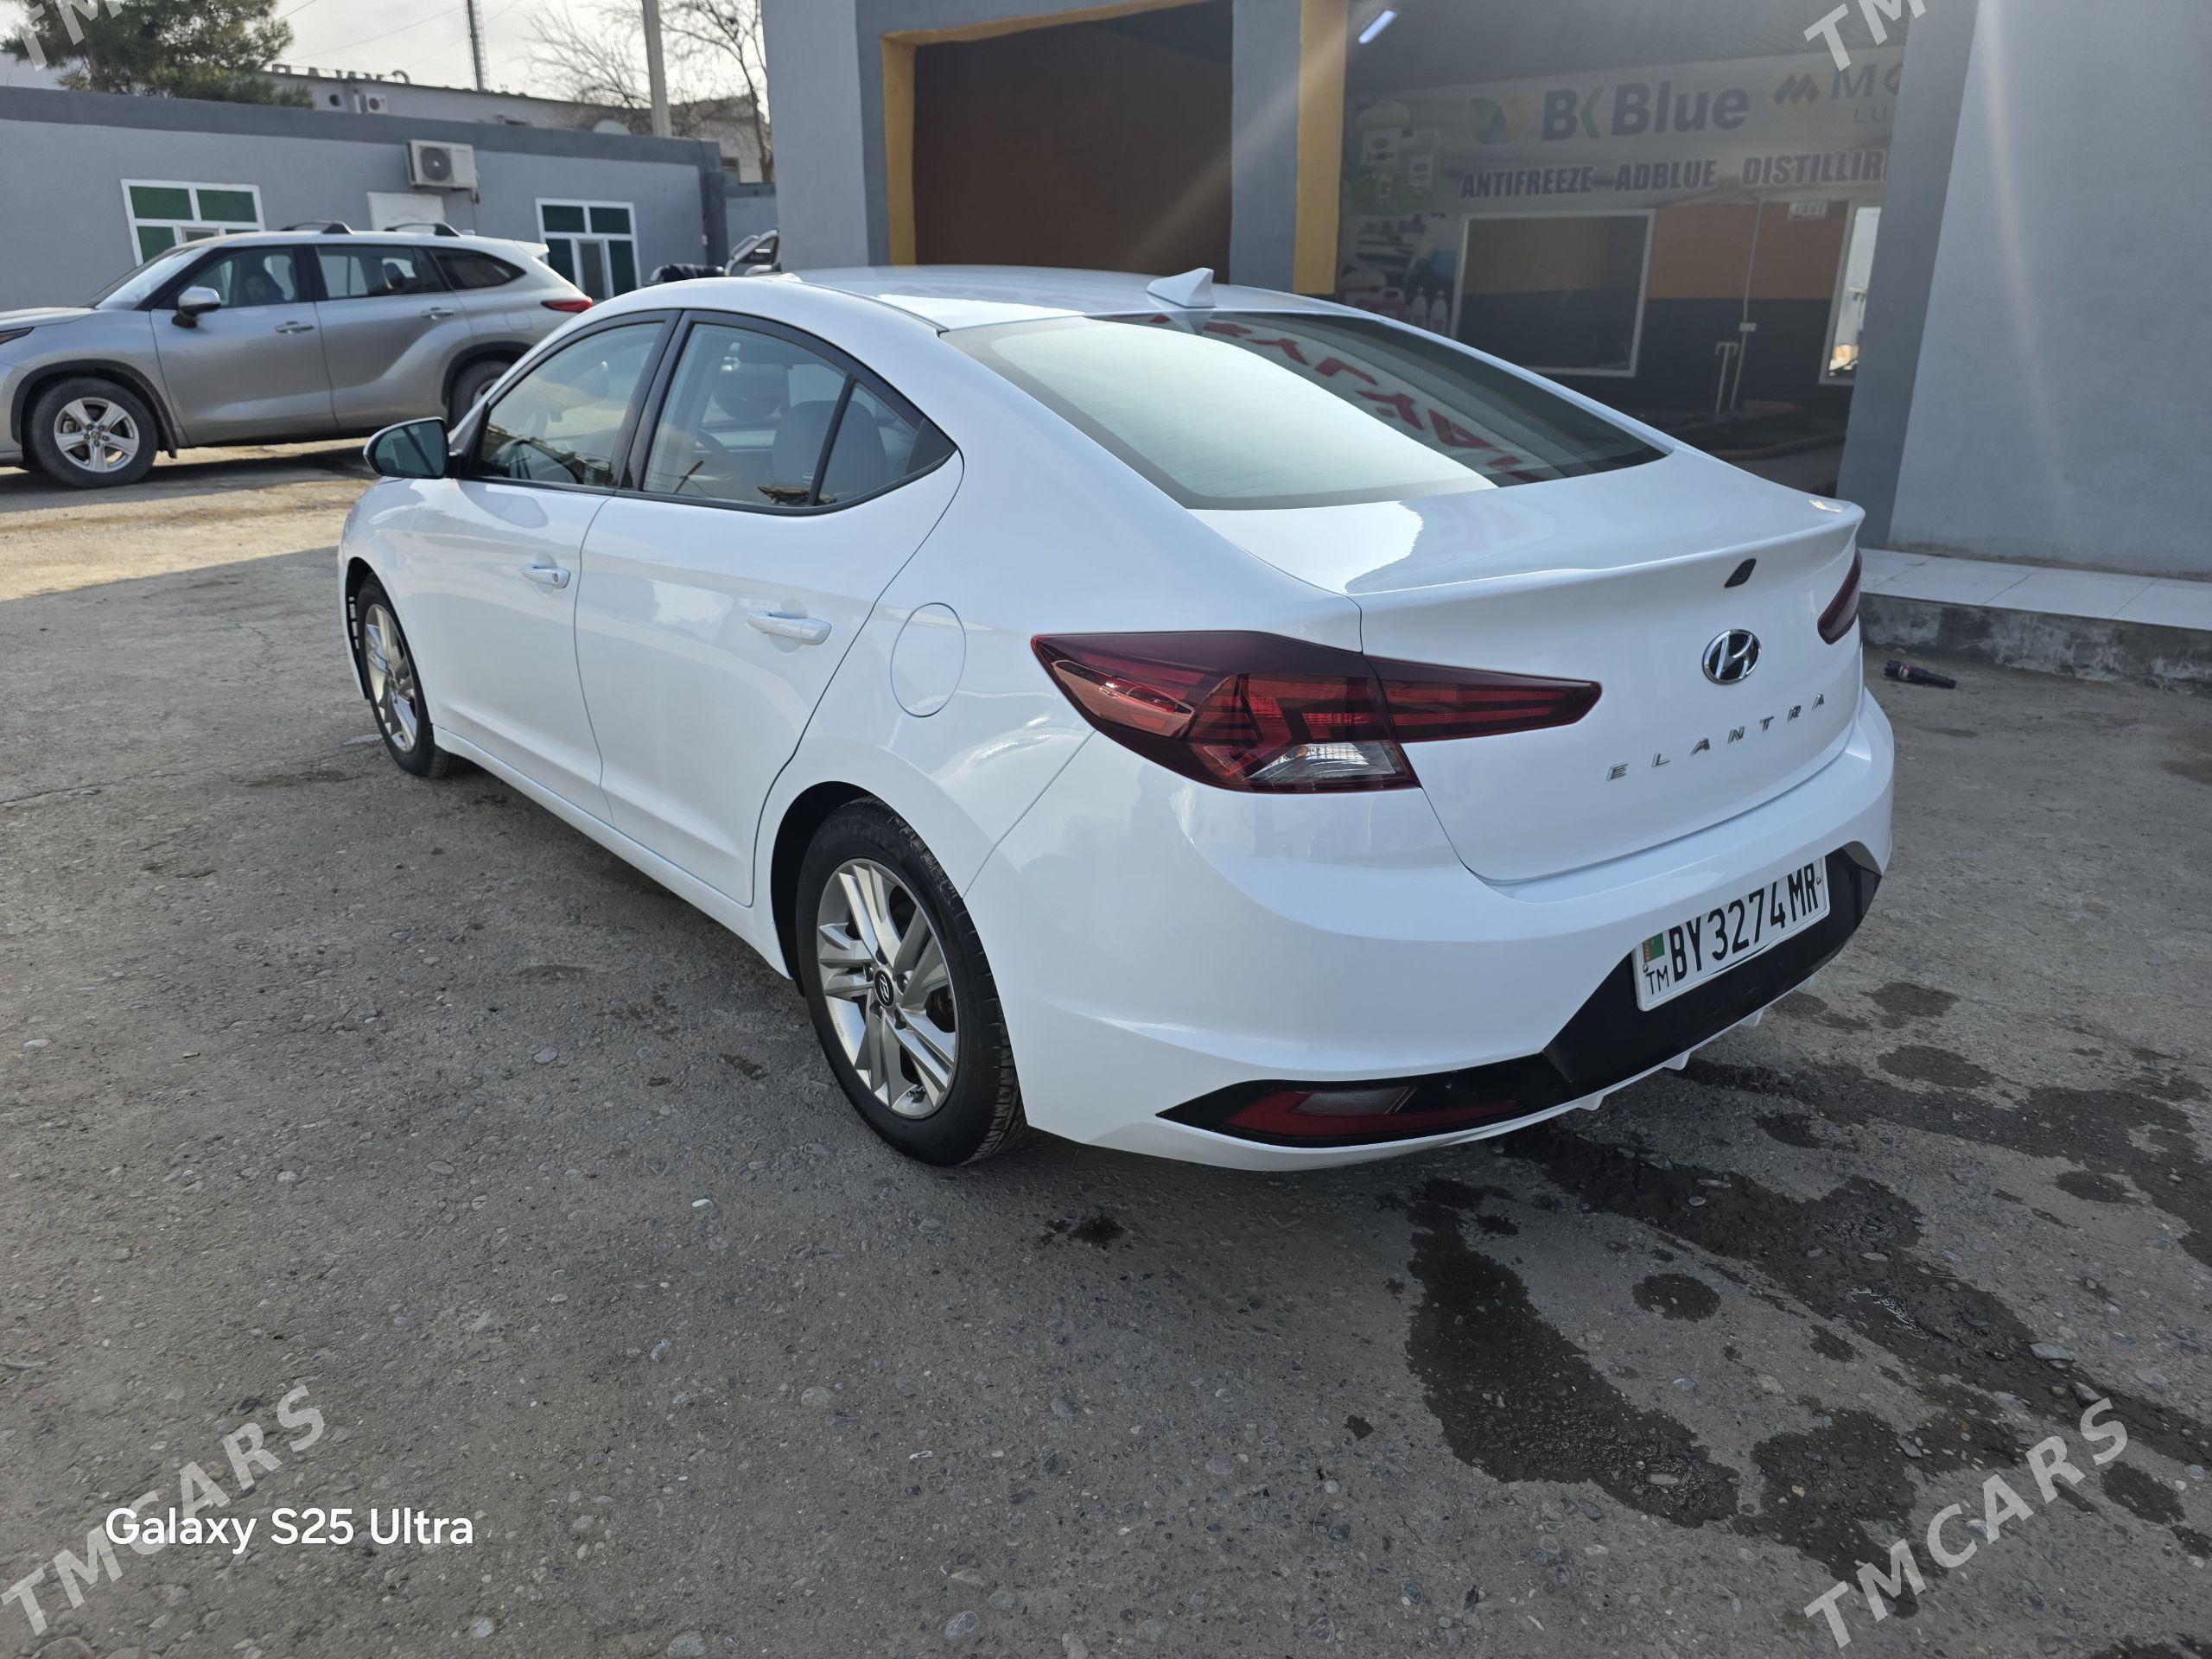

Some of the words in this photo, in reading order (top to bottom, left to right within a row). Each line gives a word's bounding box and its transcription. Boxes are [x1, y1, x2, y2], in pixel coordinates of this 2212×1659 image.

[1459, 165, 1593, 198] ANTIFREEZE
[1613, 159, 1716, 191] ADBLUE
[1741, 149, 1887, 187] DISTILLIR
[1606, 694, 1825, 781] ELANTRA
[1645, 965, 1669, 995] TM
